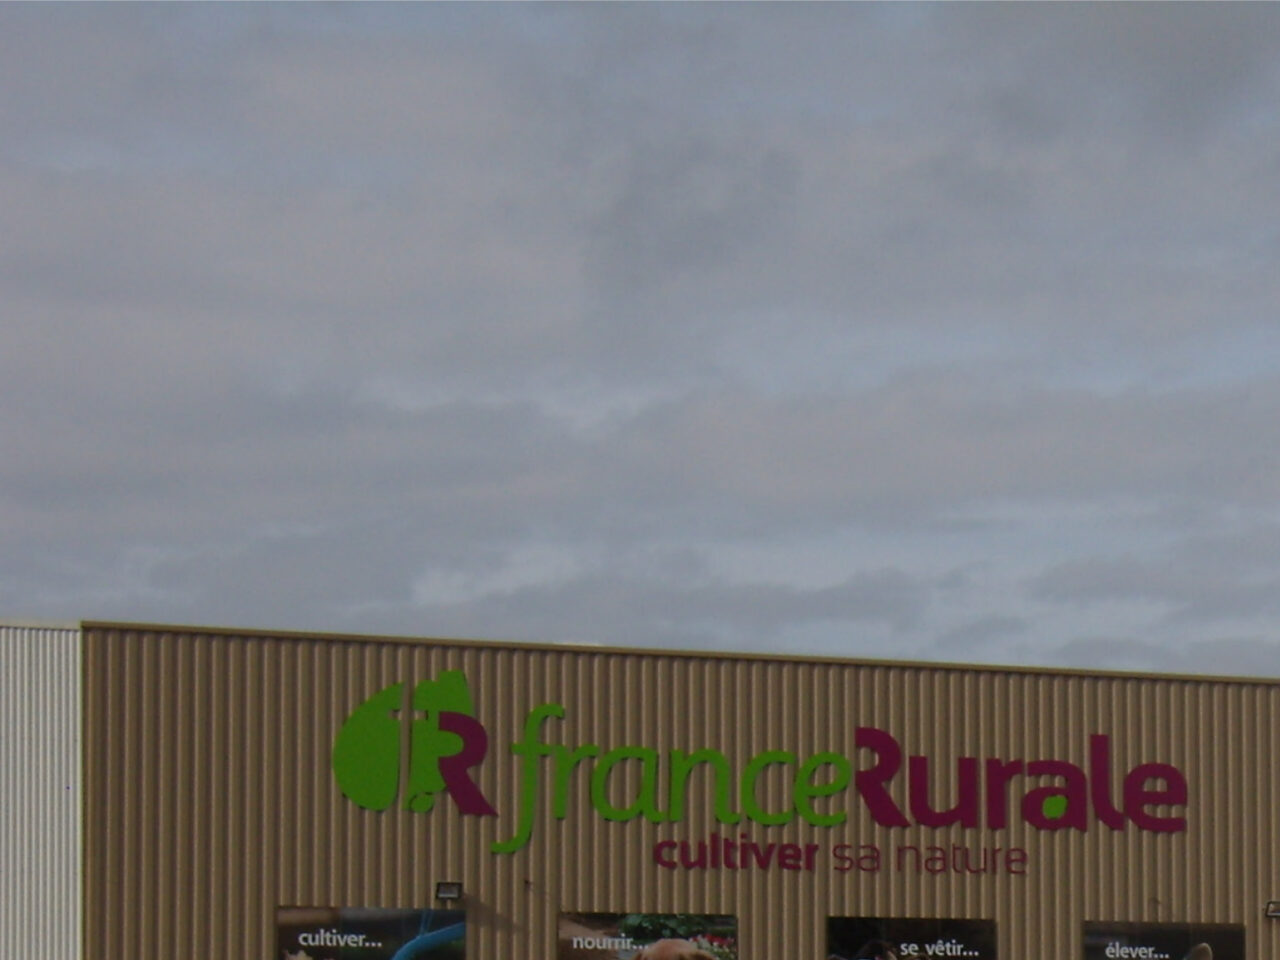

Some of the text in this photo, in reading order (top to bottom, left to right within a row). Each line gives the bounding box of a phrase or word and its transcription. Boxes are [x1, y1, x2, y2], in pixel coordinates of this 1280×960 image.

[653, 833, 1029, 876] cultiver sa nature
[298, 928, 382, 948] cultiver...
[572, 932, 649, 950] nourrir...
[900, 939, 979, 957] se vêtir...
[1105, 941, 1169, 959] élever...
